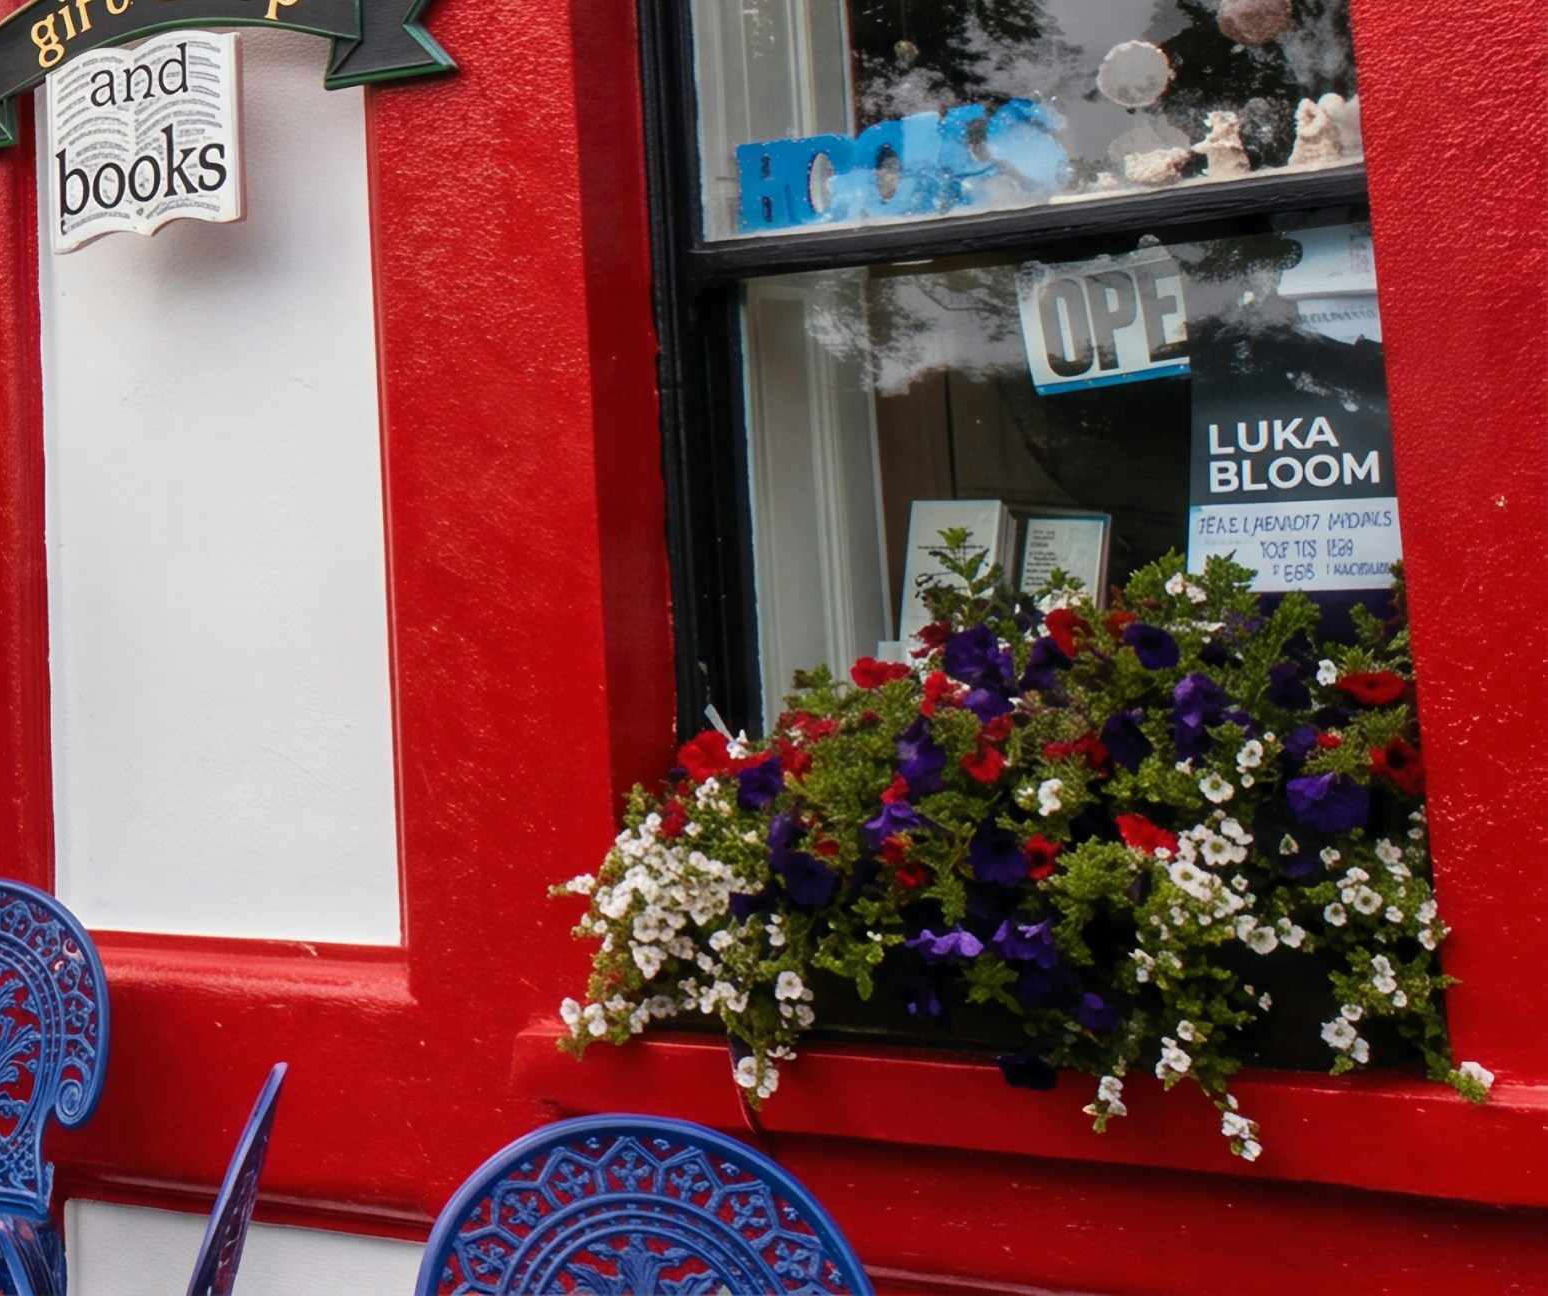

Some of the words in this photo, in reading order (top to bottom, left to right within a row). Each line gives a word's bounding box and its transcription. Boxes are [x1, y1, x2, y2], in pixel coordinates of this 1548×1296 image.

[90, 42, 189, 107] and
[55, 124, 228, 216] books
[1208, 416, 1340, 455] LUKA
[1209, 450, 1381, 493] BLOOM
